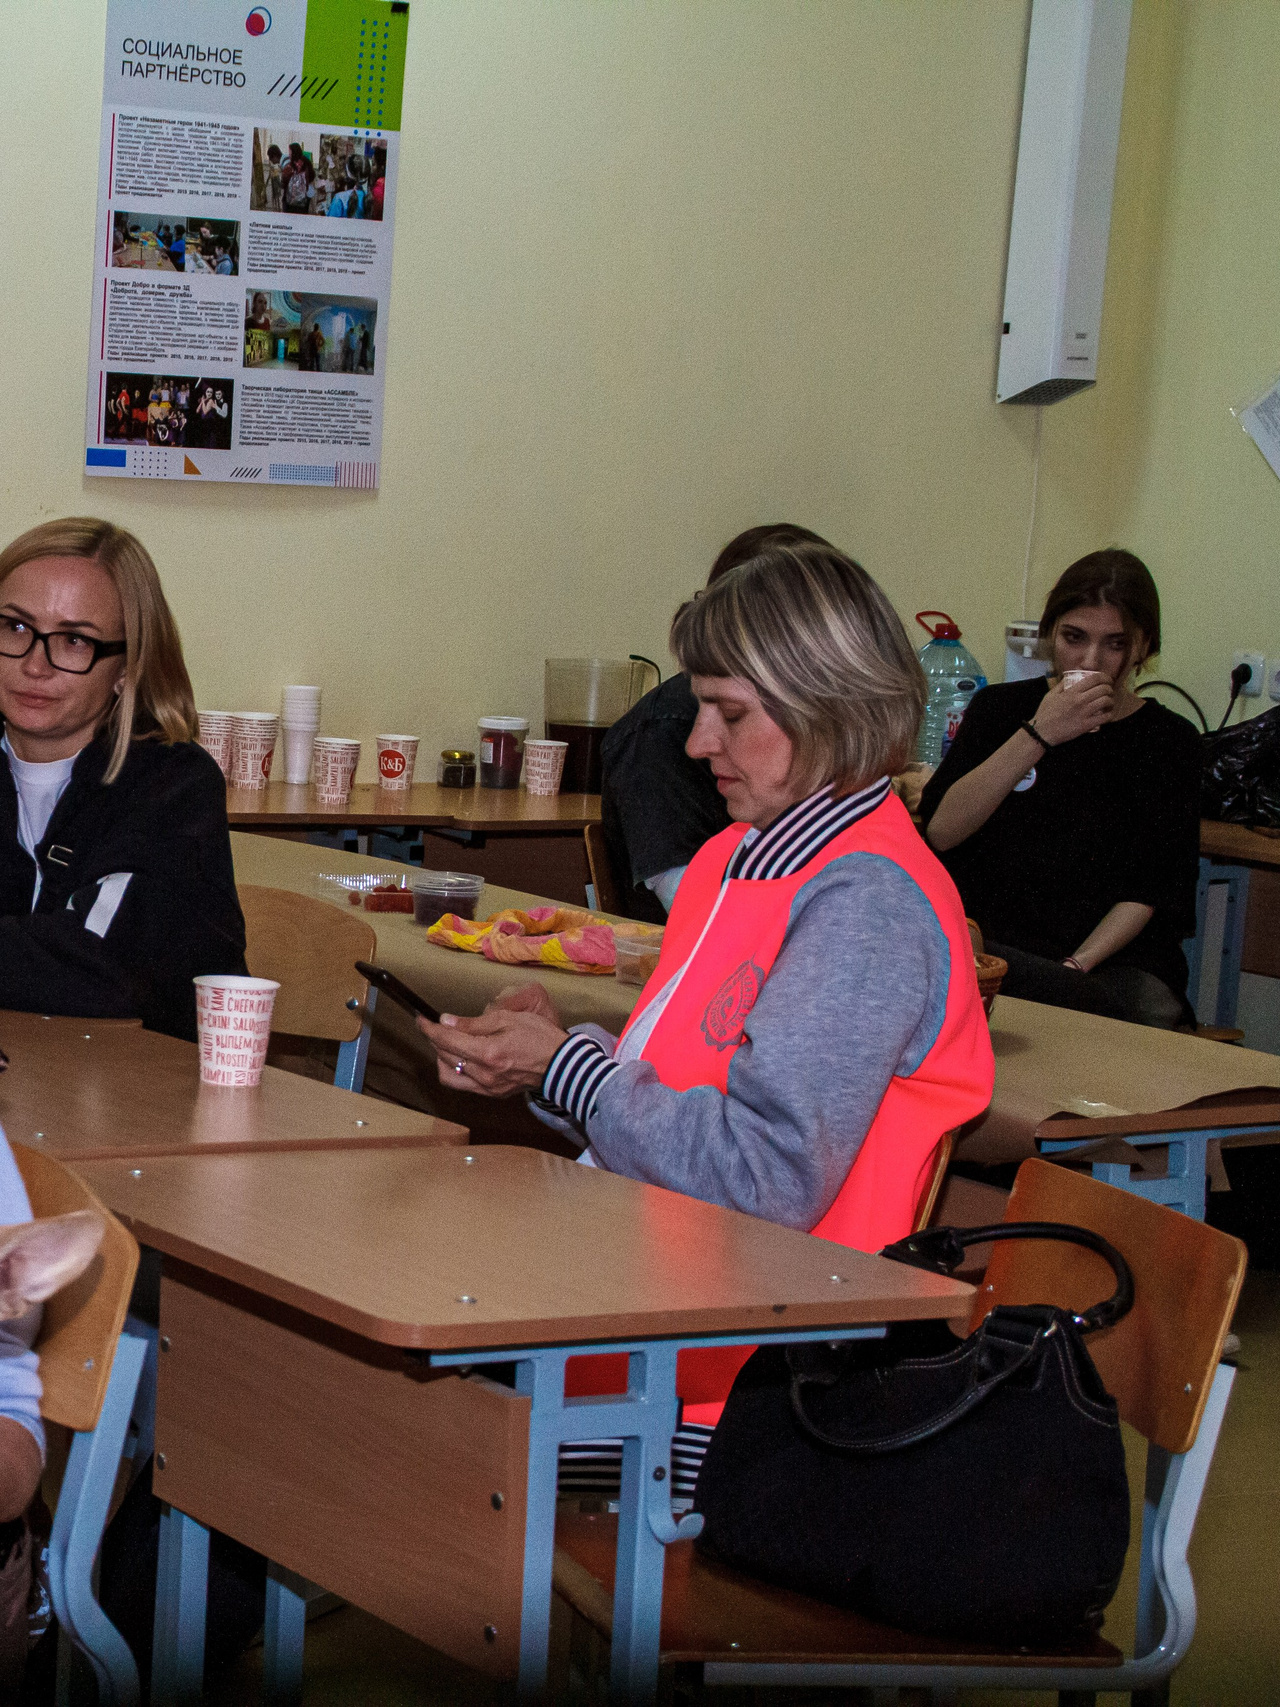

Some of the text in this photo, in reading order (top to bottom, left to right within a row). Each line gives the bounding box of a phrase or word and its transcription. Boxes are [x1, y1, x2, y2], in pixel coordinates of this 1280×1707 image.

[122, 37, 243, 65] СОЦИАЛЬНОЕ
[121, 60, 246, 88] ПАРТНЁРСТВО
[118, 113, 138, 121] Проект
[139, 115, 176, 124] «Незаметные
[176, 119, 193, 127] герои
[220, 123, 239, 131] годов»
[110, 287, 192, 299] «Доброта, доверие, дружба»
[131, 281, 149, 289] Добро
[156, 283, 181, 291] формате
[241, 384, 271, 392] Творческая
[272, 386, 307, 394] лаборатория
[215, 1051, 248, 1067] PROSIT!
